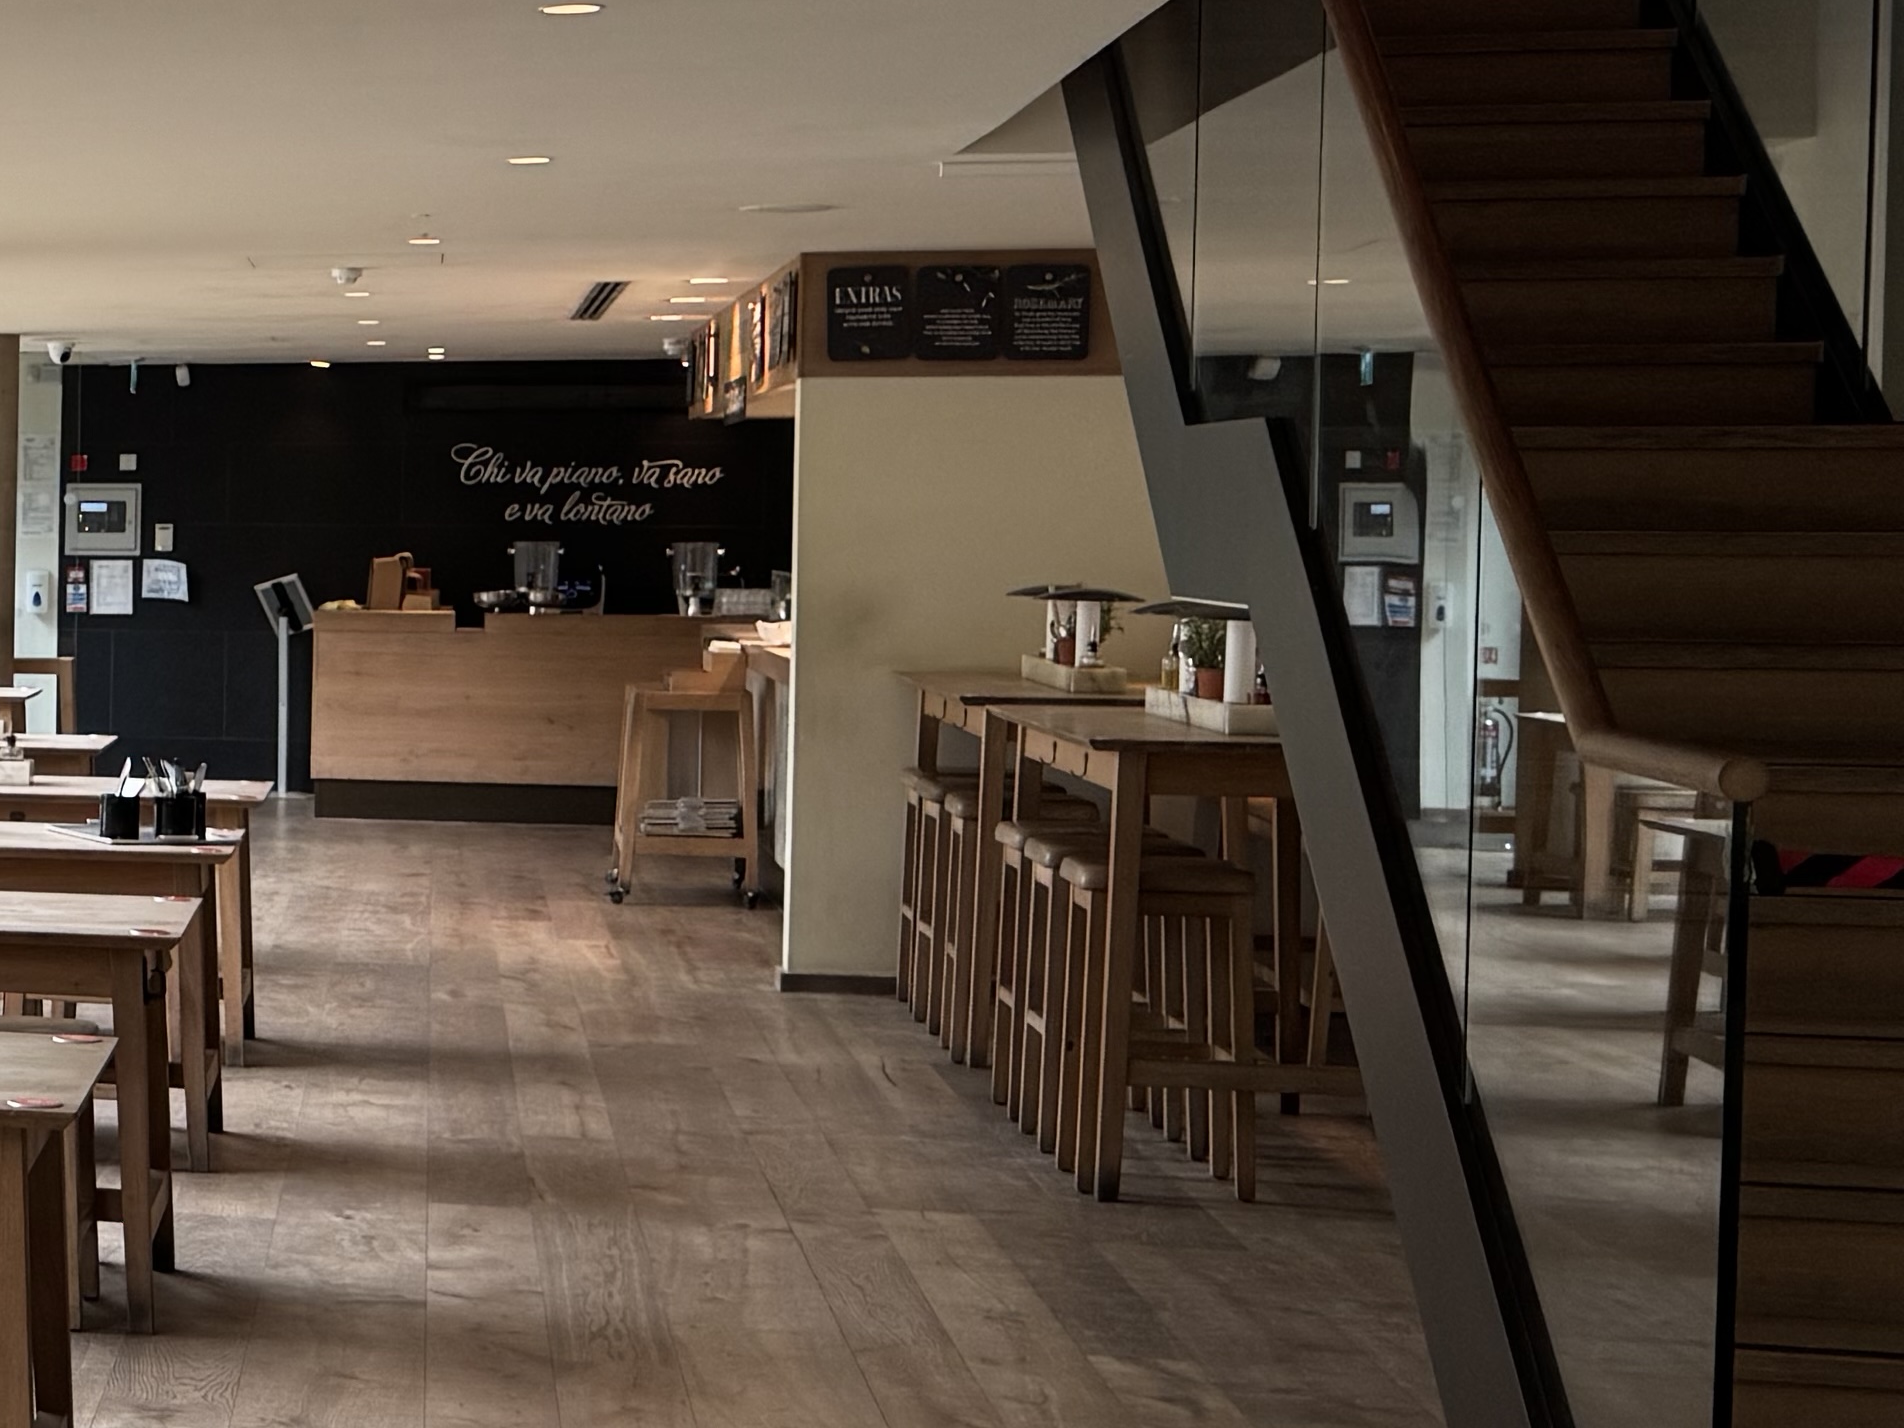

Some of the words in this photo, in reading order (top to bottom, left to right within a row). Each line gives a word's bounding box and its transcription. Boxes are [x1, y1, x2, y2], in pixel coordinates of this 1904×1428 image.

[835, 285, 903, 305] EXTRAS
[450, 442, 511, 486] Chi
[513, 460, 542, 488] va
[631, 459, 665, 489] va
[662, 462, 725, 489] sano
[504, 502, 522, 522] e
[524, 503, 553, 525] va
[559, 490, 655, 526] lontano
